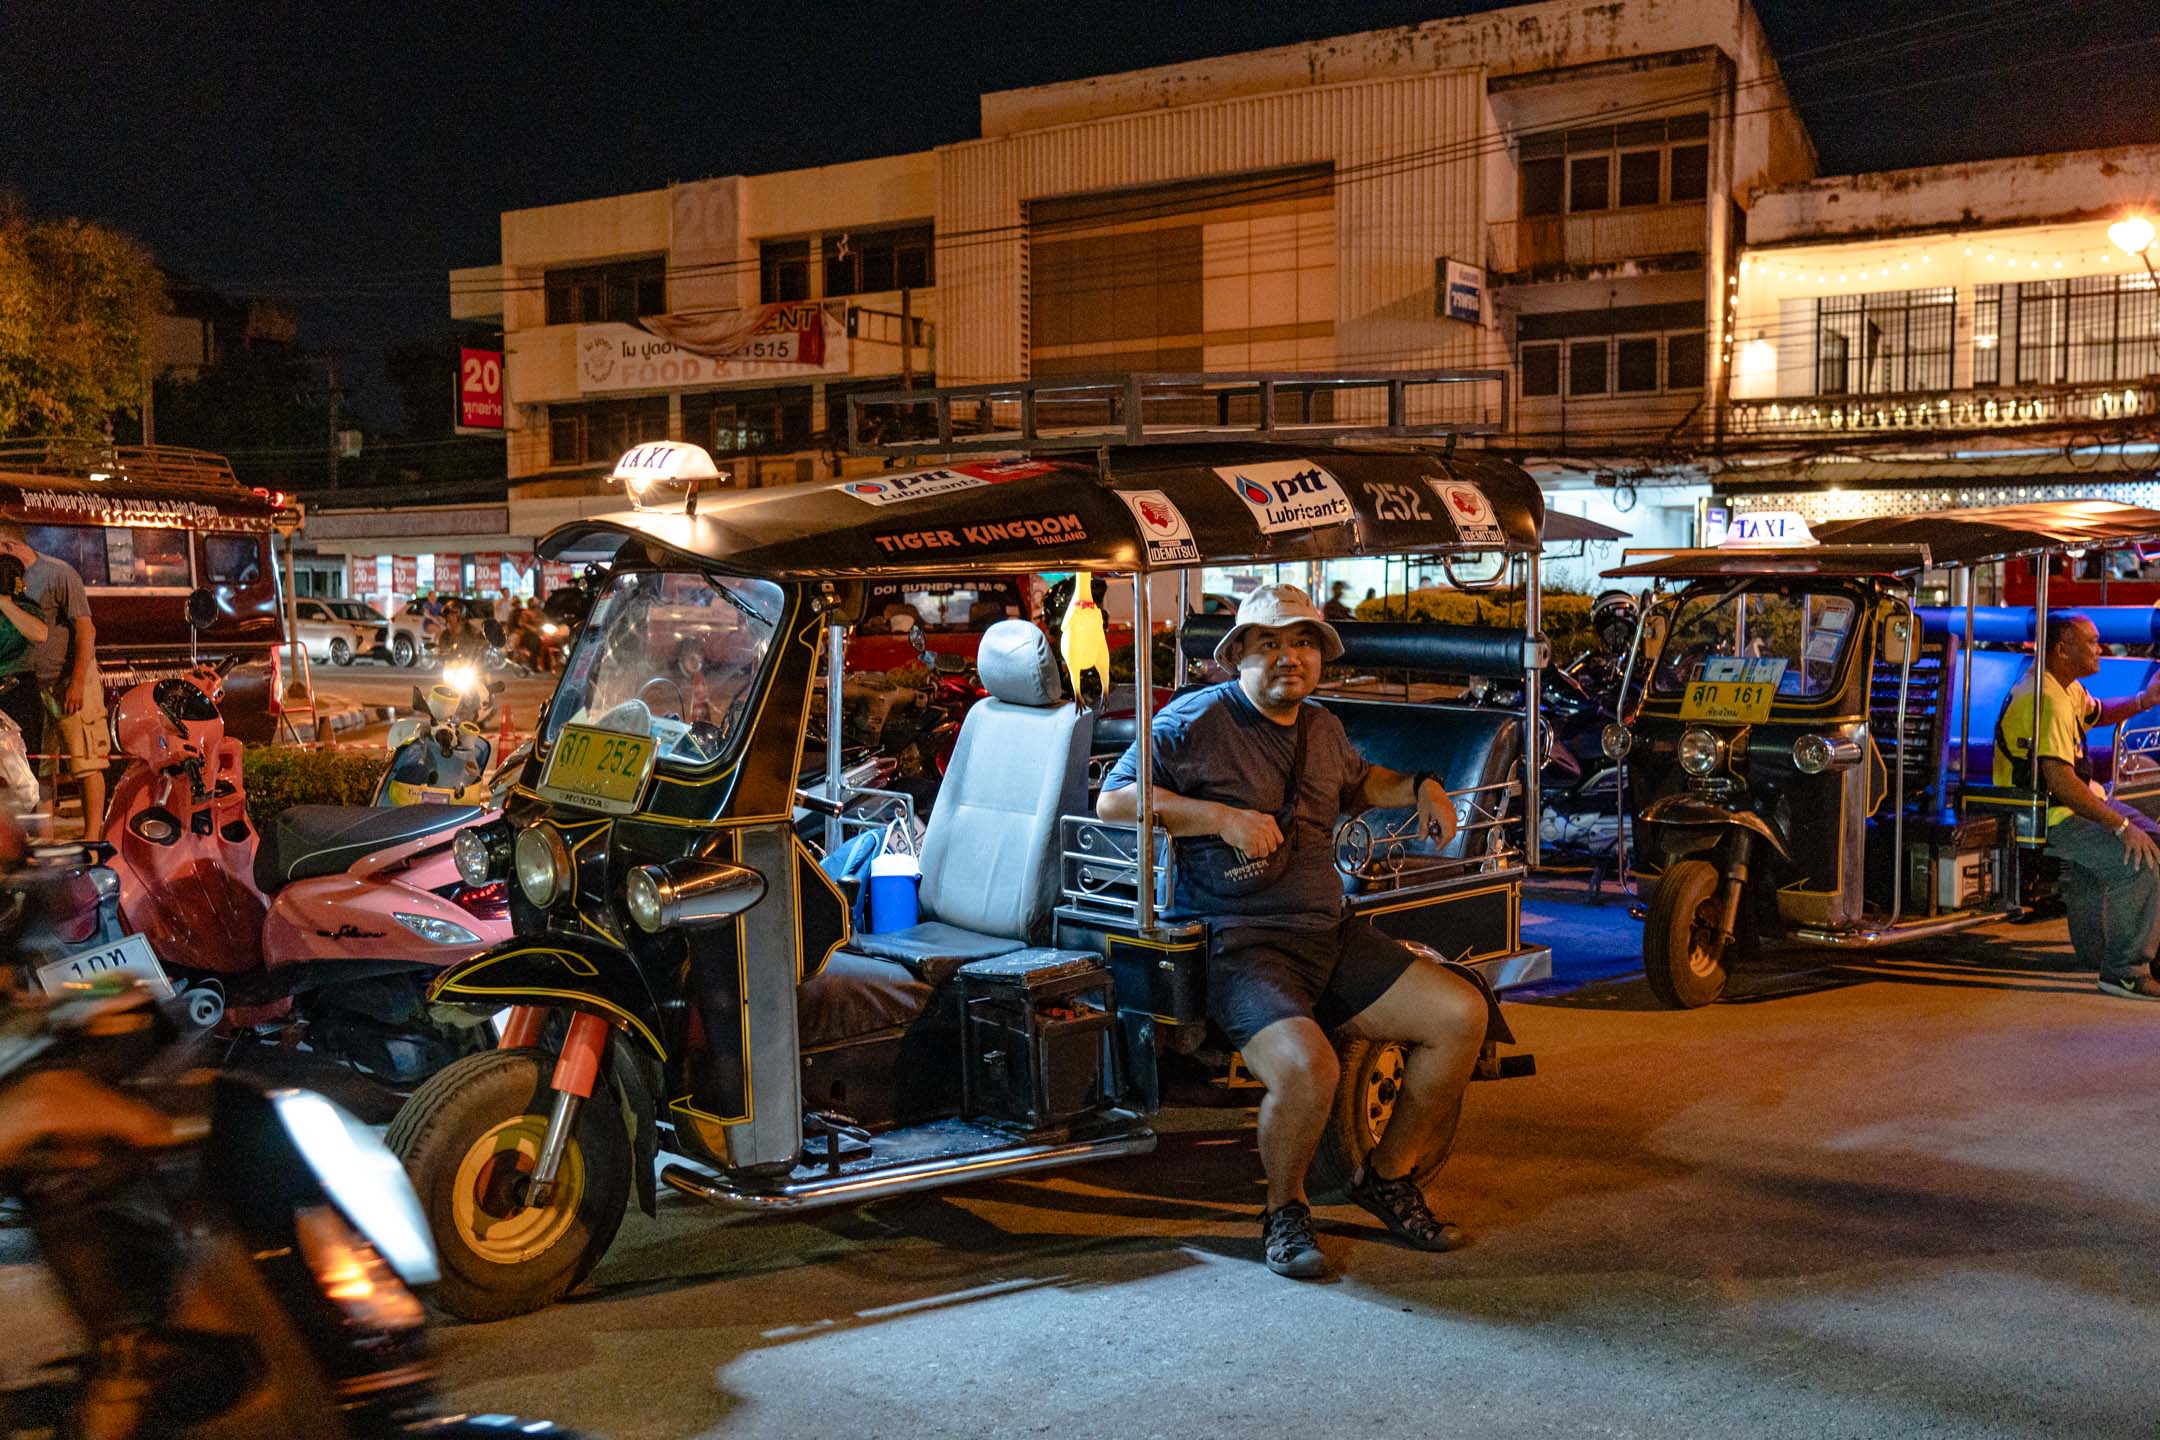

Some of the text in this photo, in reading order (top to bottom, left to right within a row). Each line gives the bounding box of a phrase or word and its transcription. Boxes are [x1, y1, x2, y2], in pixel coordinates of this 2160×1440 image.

[641, 341, 678, 361] ปูดอ
[463, 357, 500, 394] 20
[622, 358, 701, 386] FOOD
[463, 399, 503, 420] ทุกอย่าง
[621, 446, 675, 469] TAXI
[878, 479, 981, 501] Lubricants
[890, 470, 955, 490] ptt
[1272, 468, 1328, 503] ptt
[1266, 498, 1348, 525] Lubricants
[1363, 481, 1432, 521] 252
[875, 513, 1083, 552] TIGER KINGDOM
[1033, 530, 1087, 546] THAILAND
[1735, 519, 1785, 538] TAXI
[1150, 545, 1195, 560] IDEMITSU
[544, 576, 559, 591] 20
[874, 584, 897, 596] DOI
[901, 582, 953, 593] SUTHEP
[1734, 686, 1763, 704] 161
[597, 739, 640, 776] 252
[564, 793, 602, 808] HONDA
